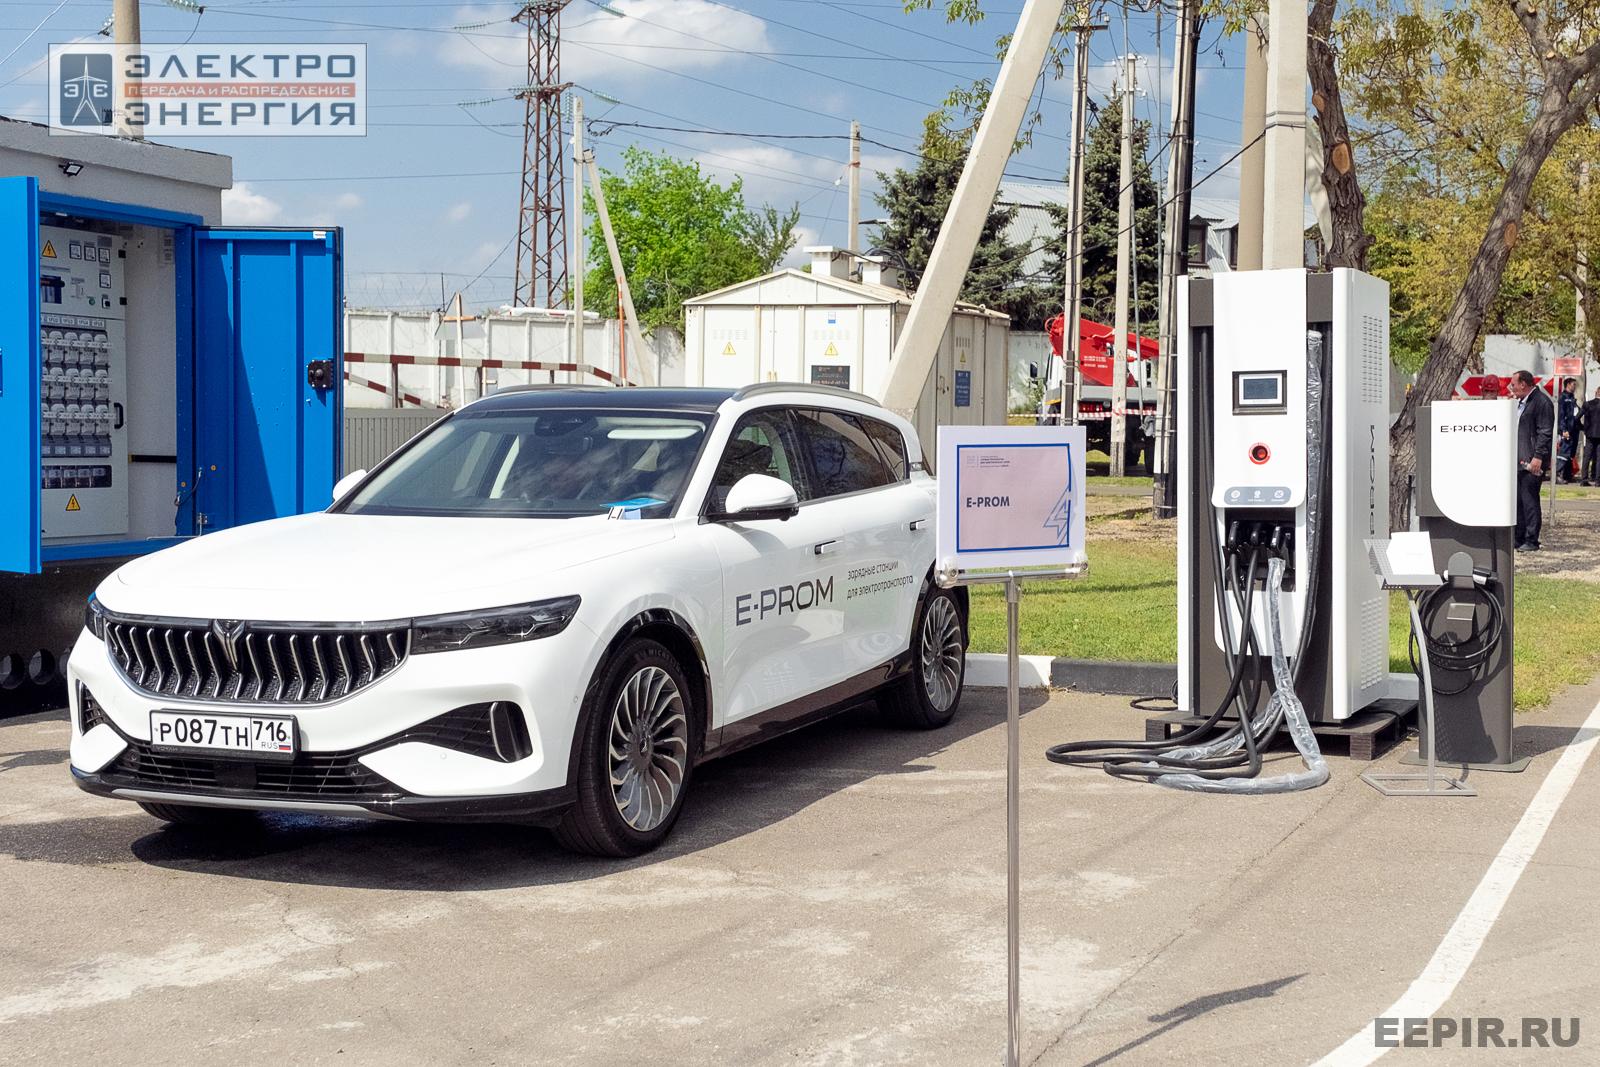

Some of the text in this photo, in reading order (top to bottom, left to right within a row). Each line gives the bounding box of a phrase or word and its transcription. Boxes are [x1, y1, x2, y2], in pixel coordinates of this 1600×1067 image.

[1440, 424, 1497, 433] E-PROM
[966, 496, 1010, 508] E-PROM
[847, 560, 899, 582] зарядные станции
[846, 575, 914, 601] для электротранспорта
[736, 575, 834, 627] E-PROM
[252, 720, 287, 742] 716
[261, 741, 279, 750] RUS
